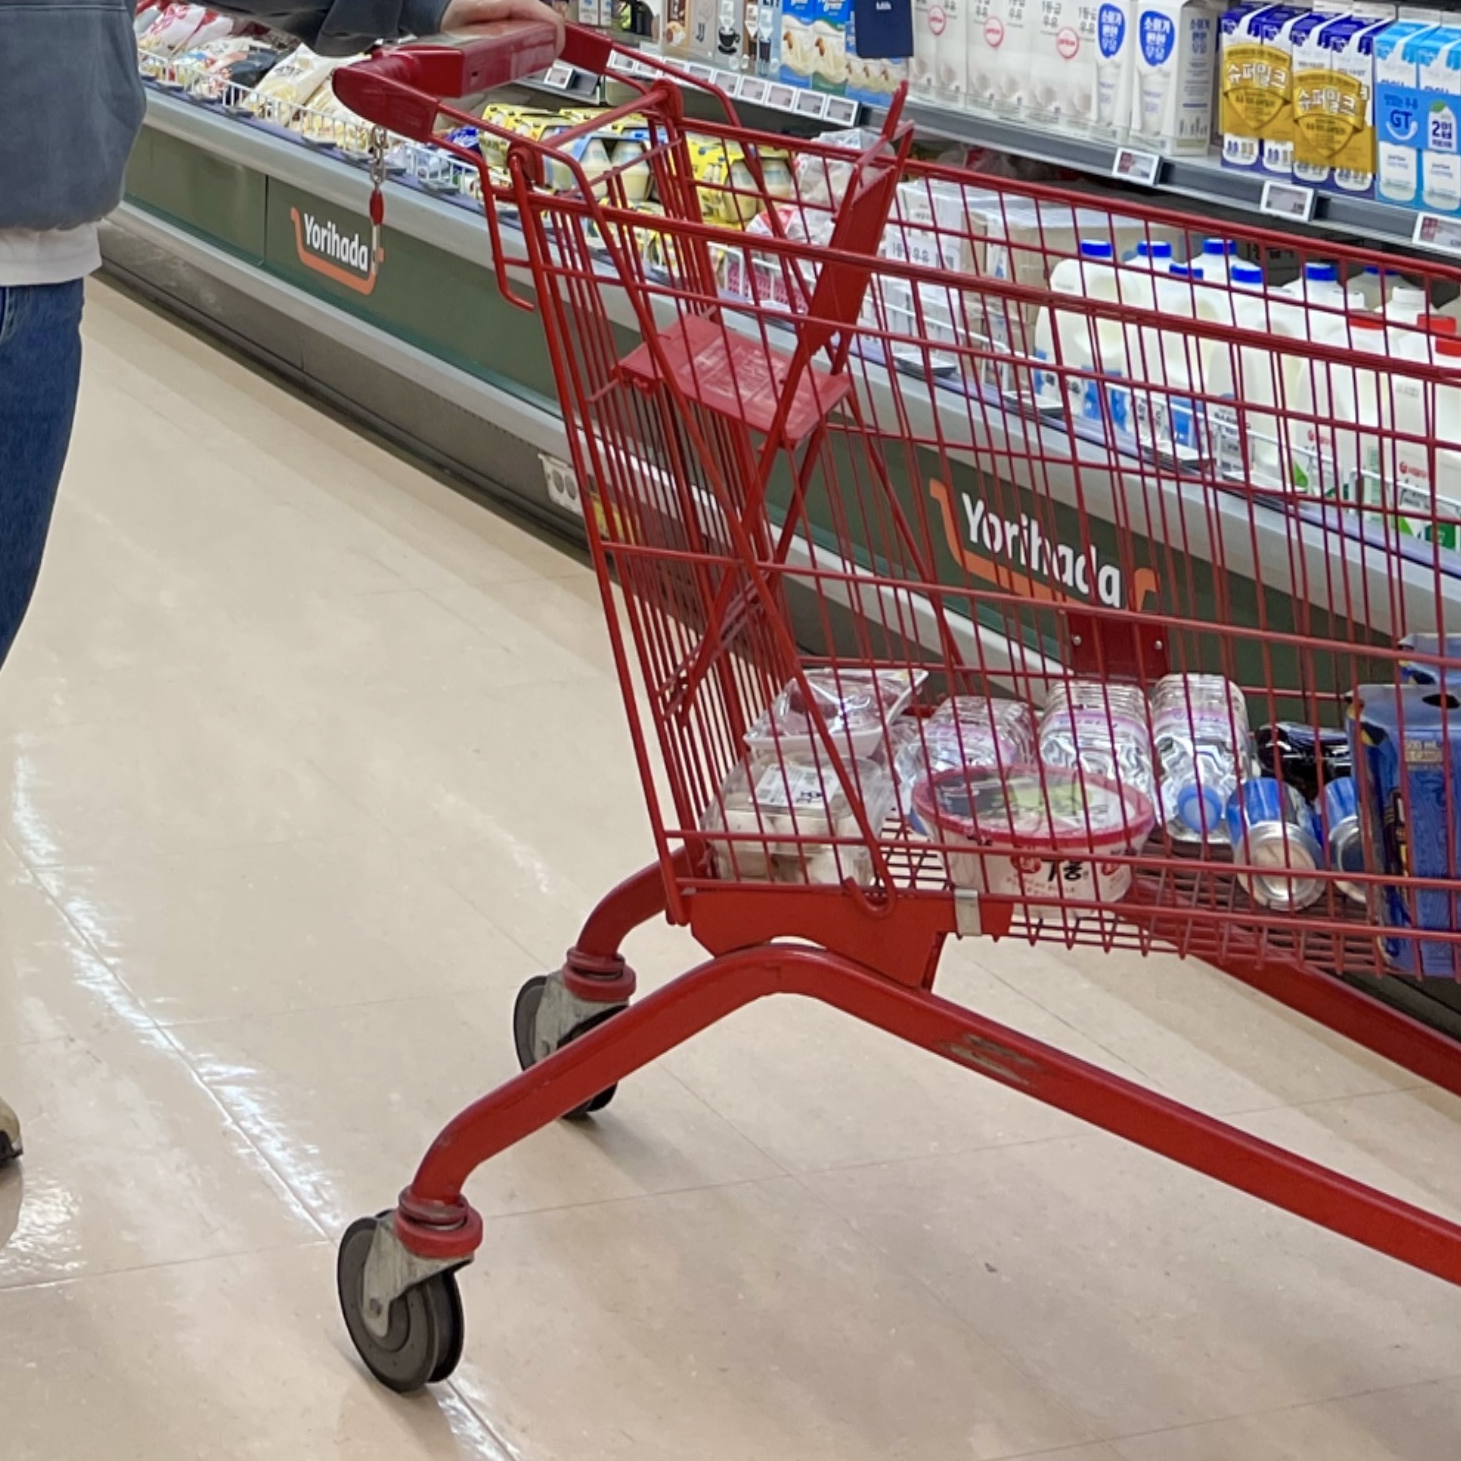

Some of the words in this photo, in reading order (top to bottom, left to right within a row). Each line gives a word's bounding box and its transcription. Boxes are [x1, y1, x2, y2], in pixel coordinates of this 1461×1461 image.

[1227, 62, 1287, 89] 슈퍼밀크
[1298, 87, 1356, 116] 슈퍼밀크
[1390, 109, 1412, 129] GT
[304, 213, 369, 272] Yorihada
[961, 492, 1121, 608] Yorihada
